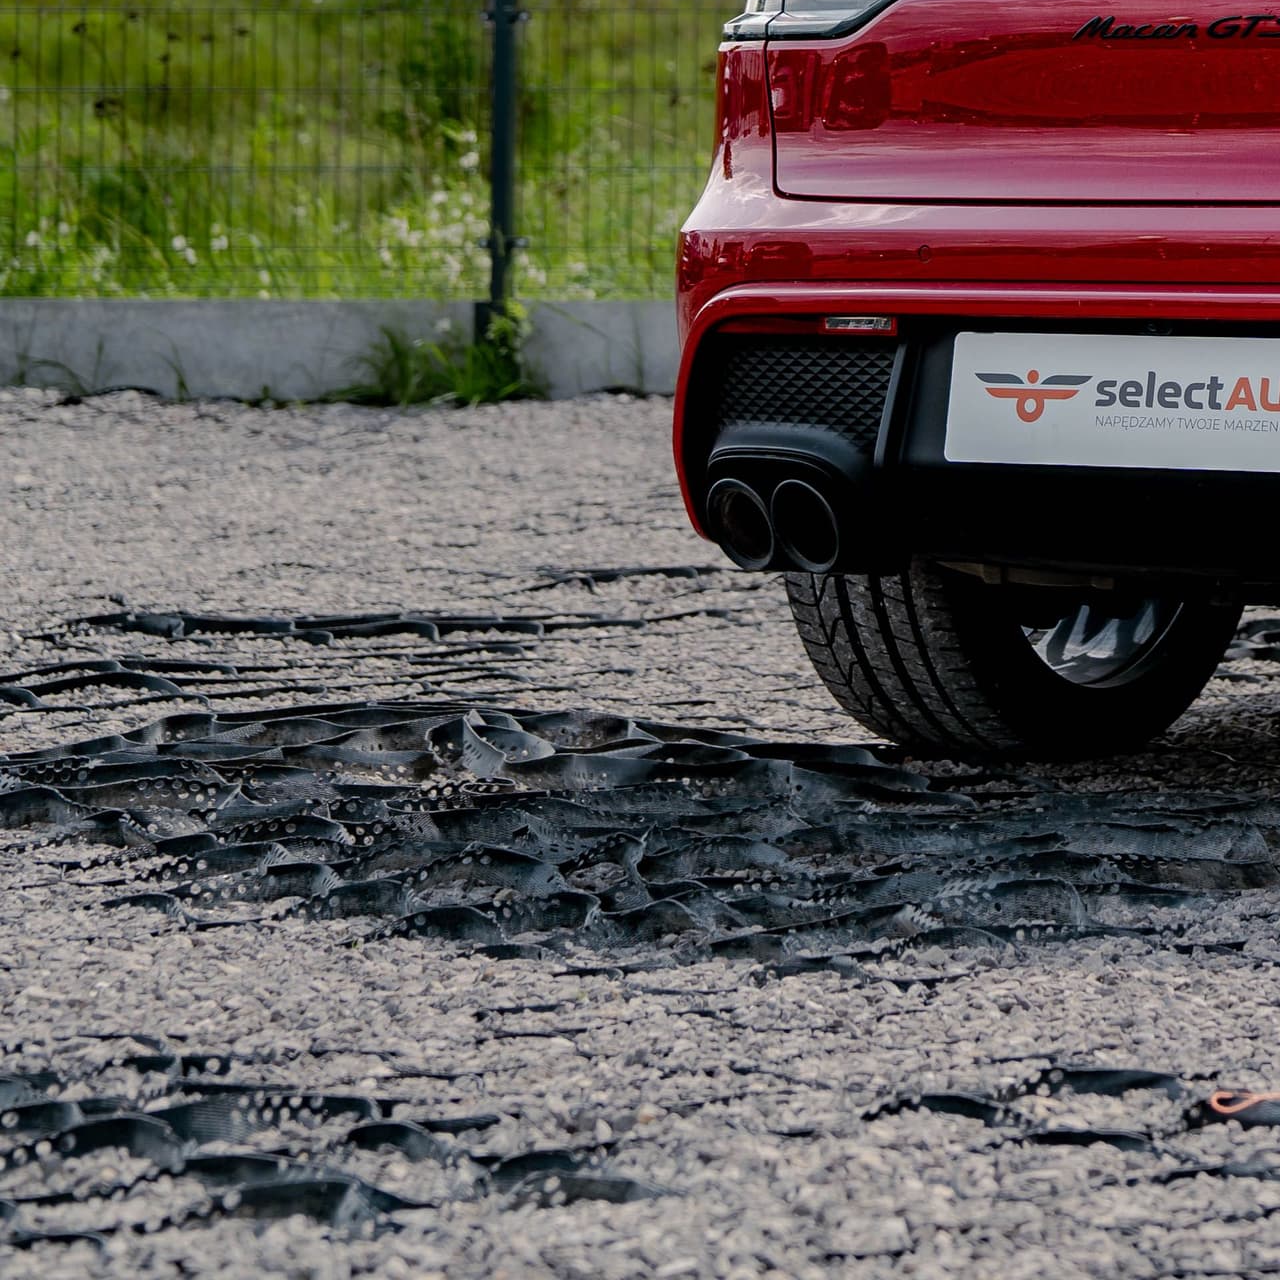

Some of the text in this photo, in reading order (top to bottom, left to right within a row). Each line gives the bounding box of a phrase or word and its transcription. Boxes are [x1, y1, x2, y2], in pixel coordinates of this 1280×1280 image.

[1072, 15, 1198, 40] Macan
[1095, 415, 1175, 430] NAPĘDZAMY
[1177, 417, 1221, 431] TWOJE
